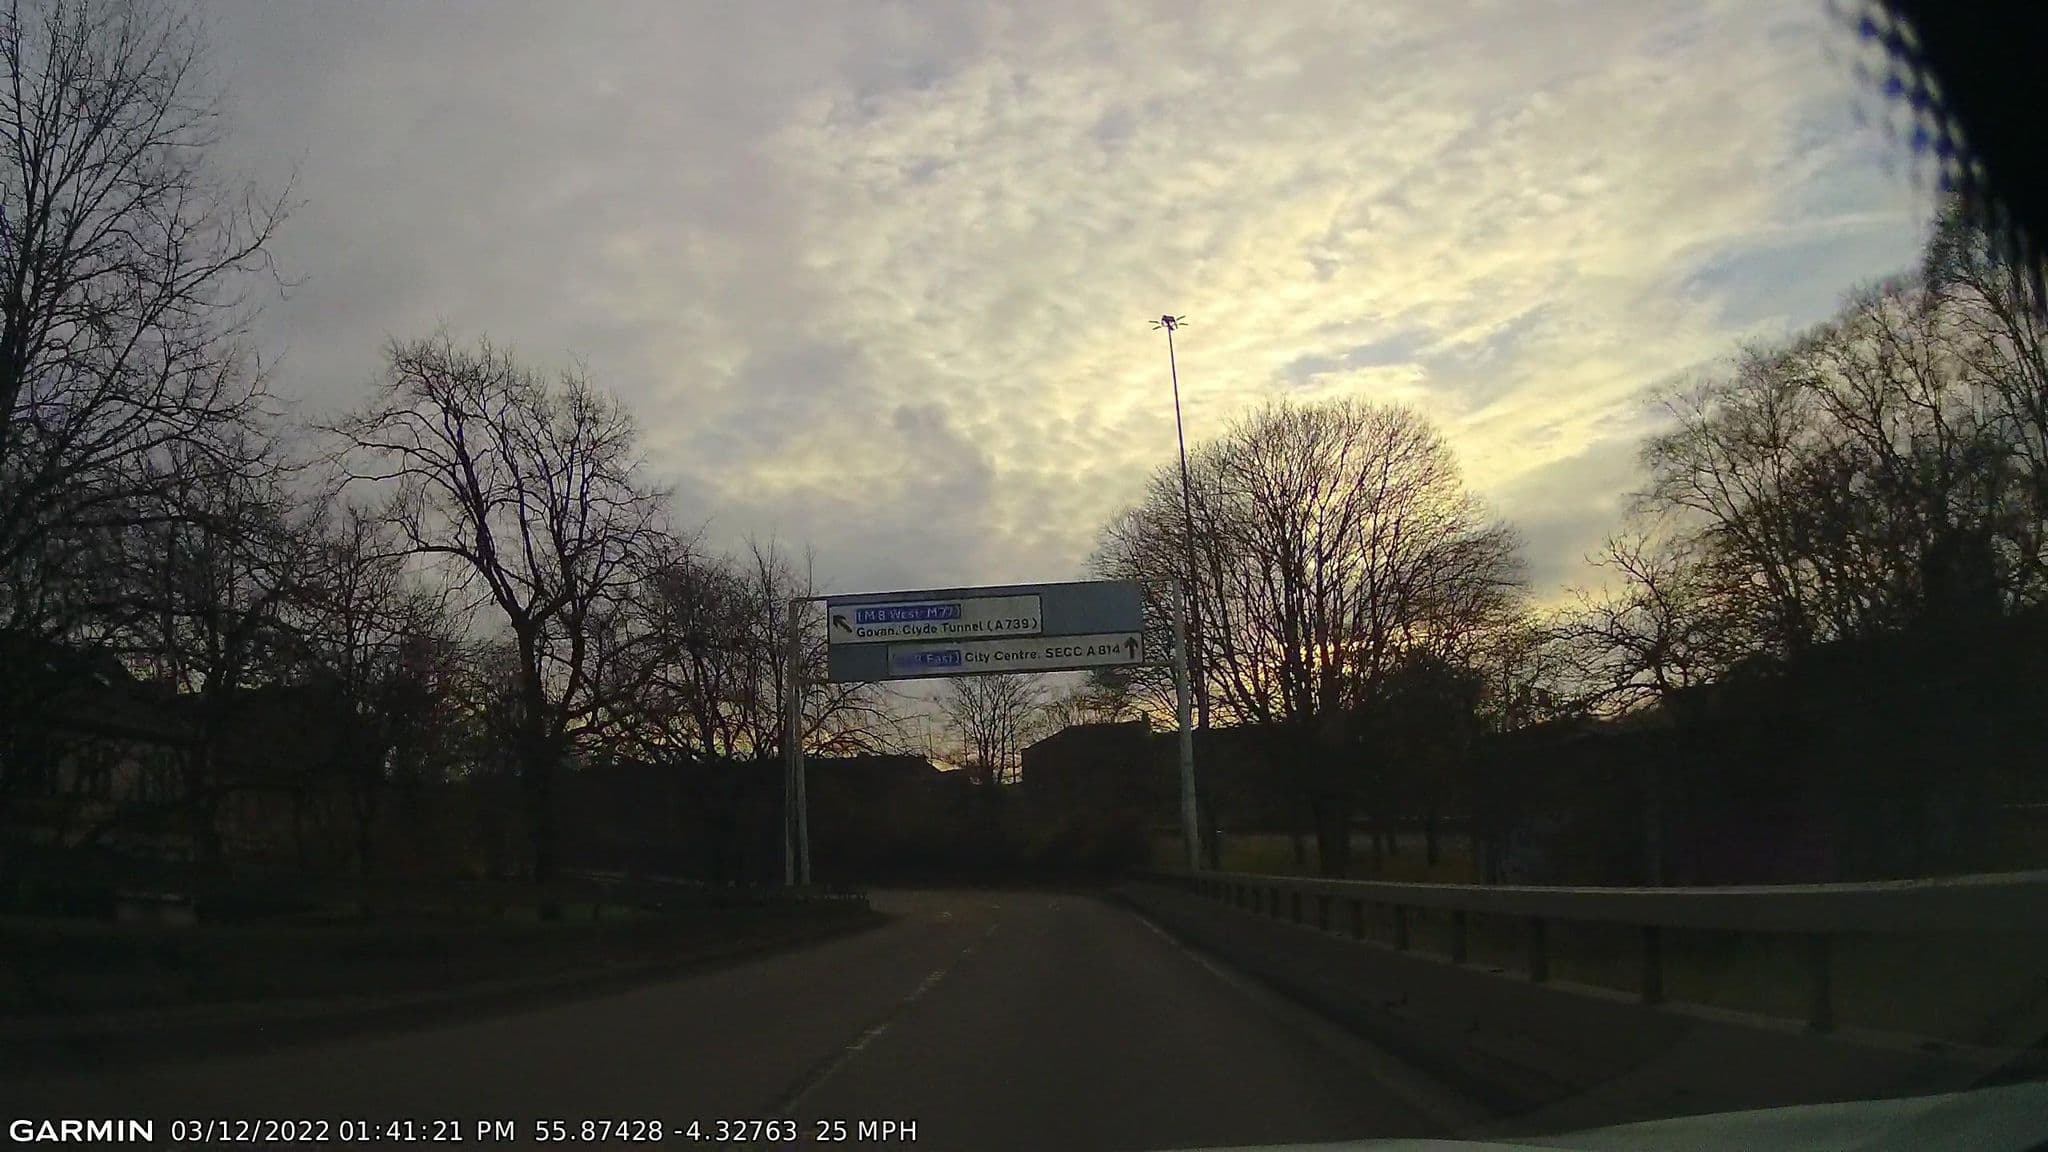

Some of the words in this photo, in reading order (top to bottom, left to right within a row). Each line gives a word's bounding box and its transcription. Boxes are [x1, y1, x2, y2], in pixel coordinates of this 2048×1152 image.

[902, 623, 937, 636] Clyde
[942, 621, 983, 633] Tunnel
[987, 617, 1038, 632] (A739)
[965, 652, 990, 664] City
[1045, 647, 1082, 659] SECC
